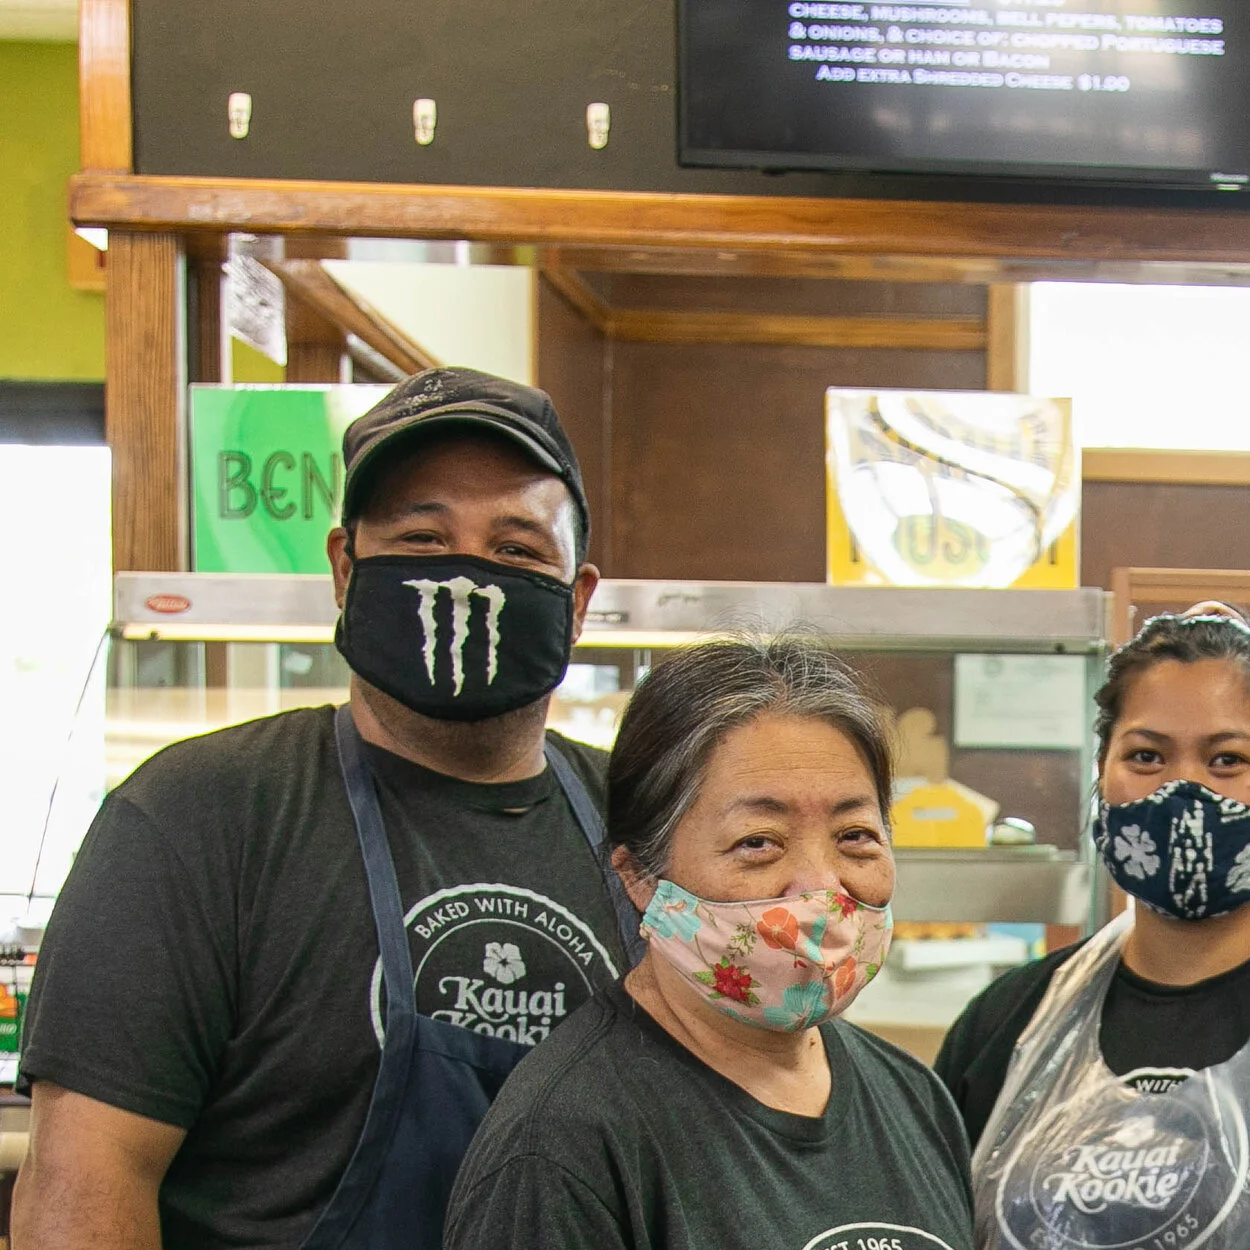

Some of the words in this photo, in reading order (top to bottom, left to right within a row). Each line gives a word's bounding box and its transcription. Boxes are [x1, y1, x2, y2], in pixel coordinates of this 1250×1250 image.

[788, 21, 807, 40] &
[904, 28, 976, 45] CHOICE
[1125, 15, 1224, 34] TOMATOES
[788, 44, 877, 62] SAUSAGE
[876, 48, 906, 64] OR
[907, 49, 950, 66] HAM
[951, 51, 981, 67] OR
[815, 64, 856, 82] ADD
[856, 68, 912, 84] EXTRA
[1005, 72, 1073, 89] CHEESE
[217, 449, 343, 520] BEN
[414, 901, 470, 939] BAKED
[474, 898, 529, 918] WITH
[534, 911, 596, 966] ALOHA
[438, 976, 567, 1022] Kauai
[1059, 1137, 1184, 1178] Kauai
[1043, 1167, 1180, 1214] Kookie
